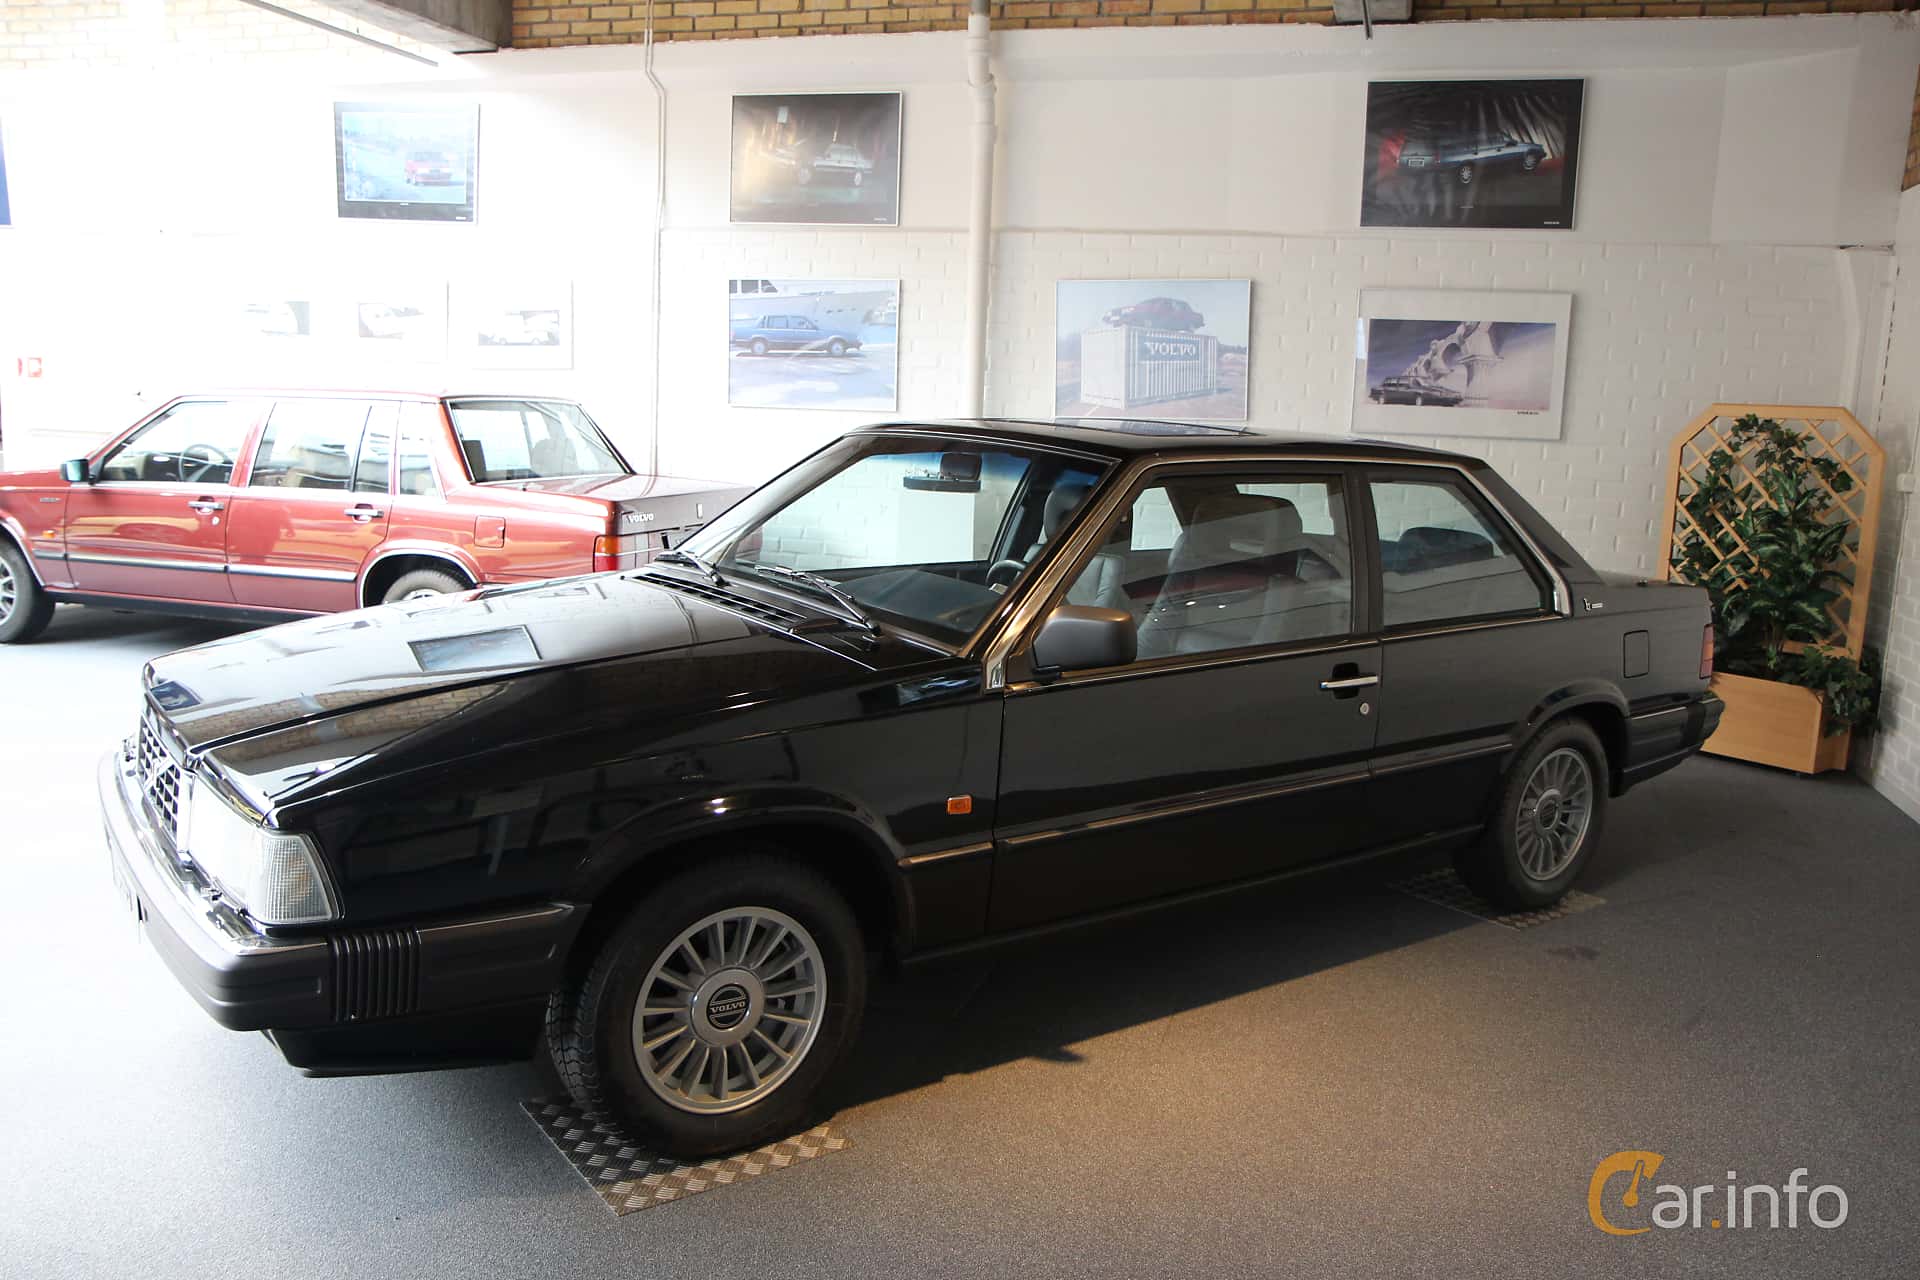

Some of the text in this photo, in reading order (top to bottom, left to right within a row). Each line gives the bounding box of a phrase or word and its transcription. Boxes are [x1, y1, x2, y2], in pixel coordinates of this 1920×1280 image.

[1143, 341, 1197, 356] VOLVO
[628, 513, 654, 523] VOLVO
[710, 1001, 746, 1013] VOLVO
